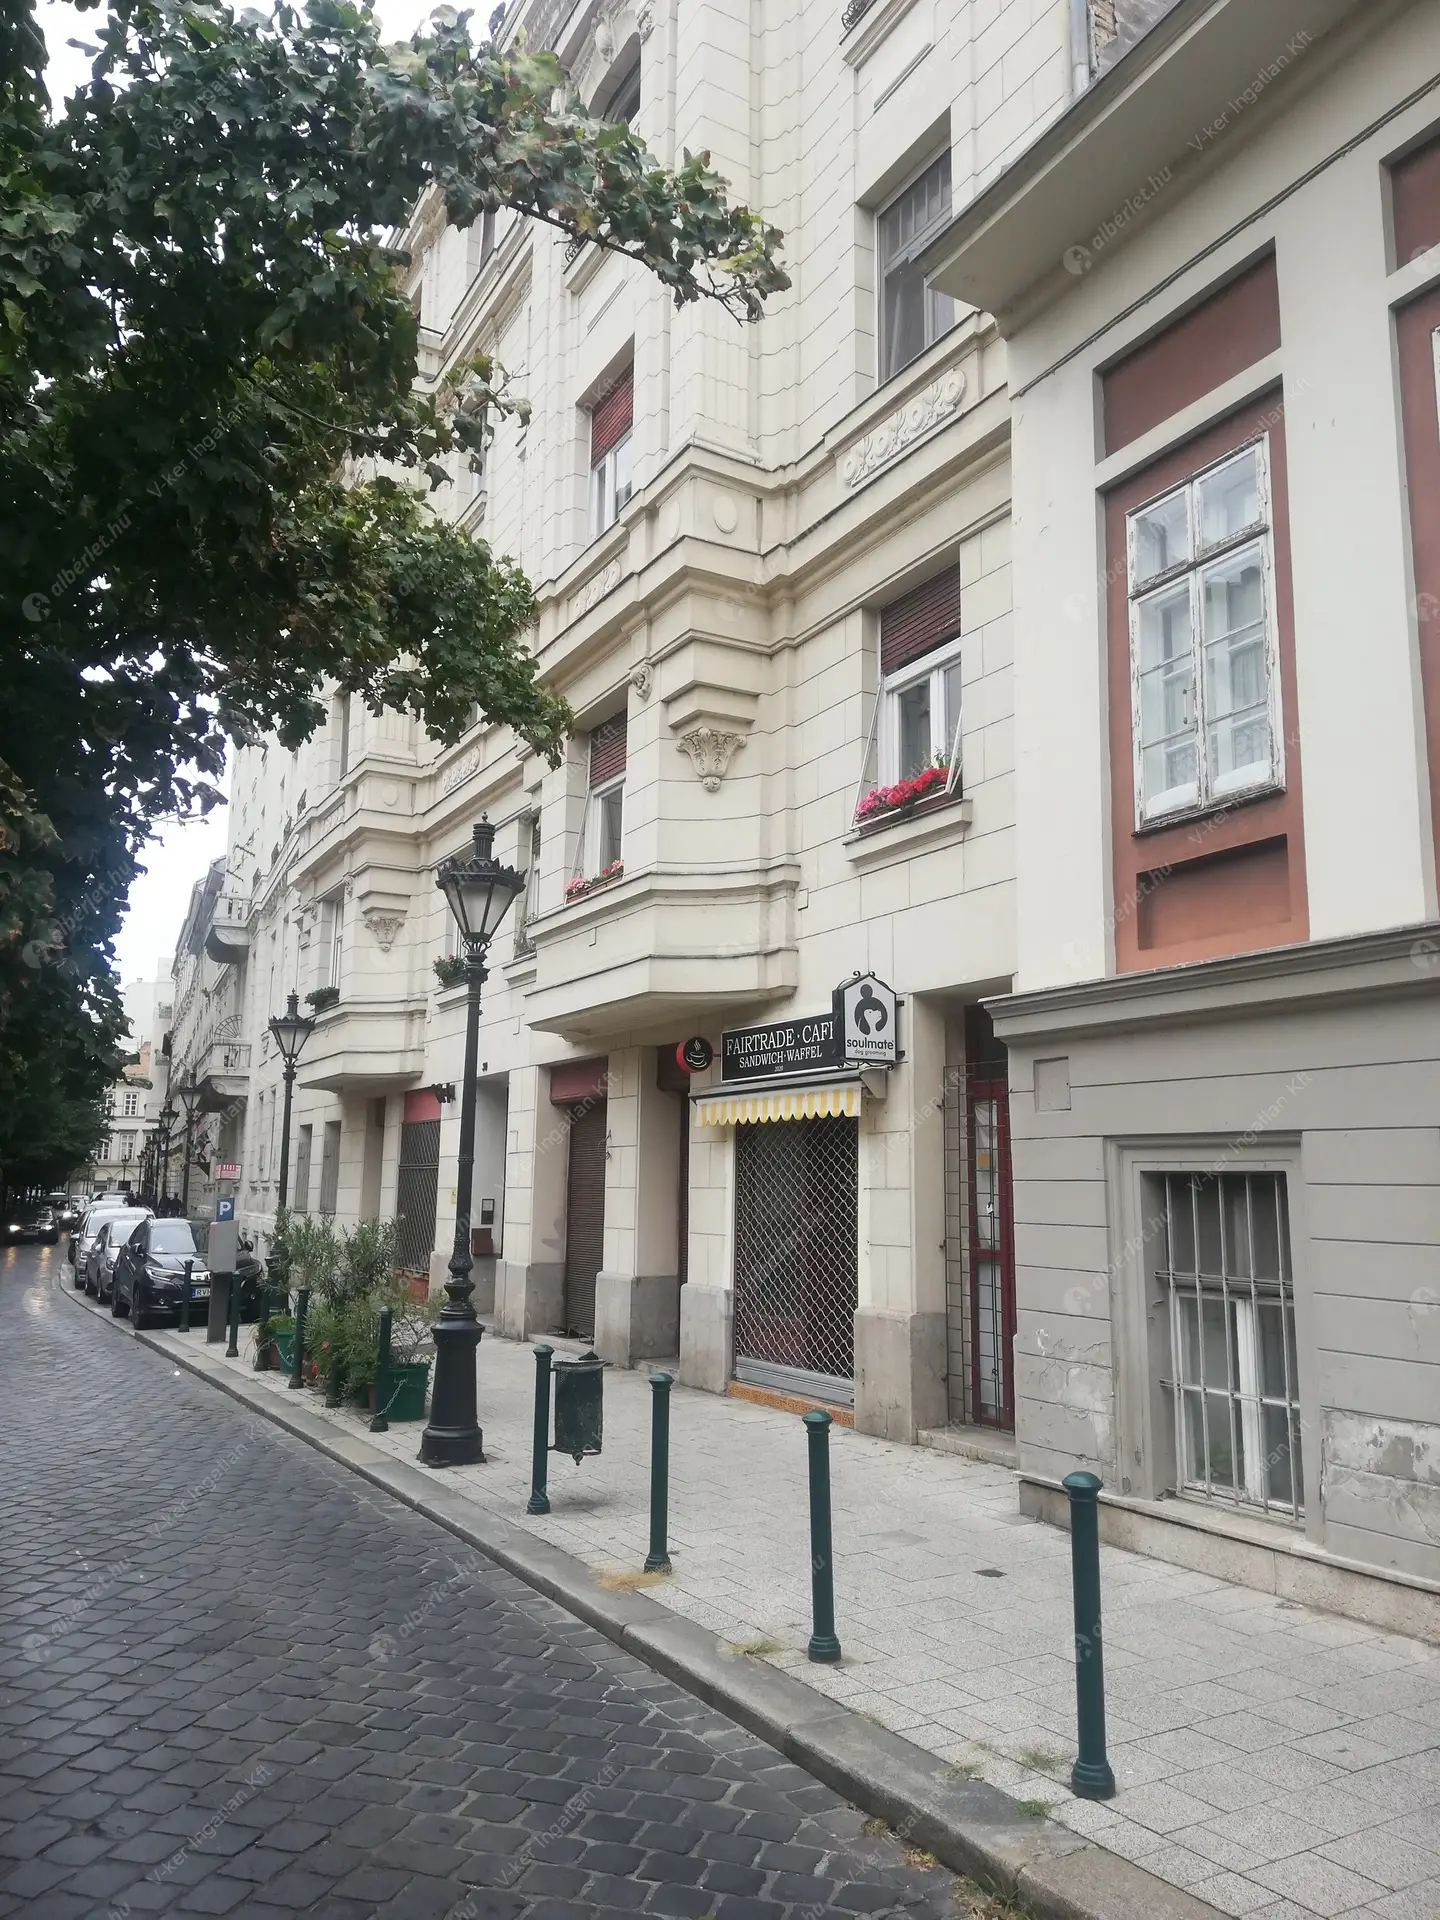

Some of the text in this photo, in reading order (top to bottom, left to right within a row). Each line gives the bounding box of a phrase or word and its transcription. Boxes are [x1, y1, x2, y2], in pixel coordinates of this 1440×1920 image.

[726, 1028, 795, 1056] FAIRTRADE
[846, 1037, 893, 1050] soulmate
[219, 1201, 232, 1216] P
